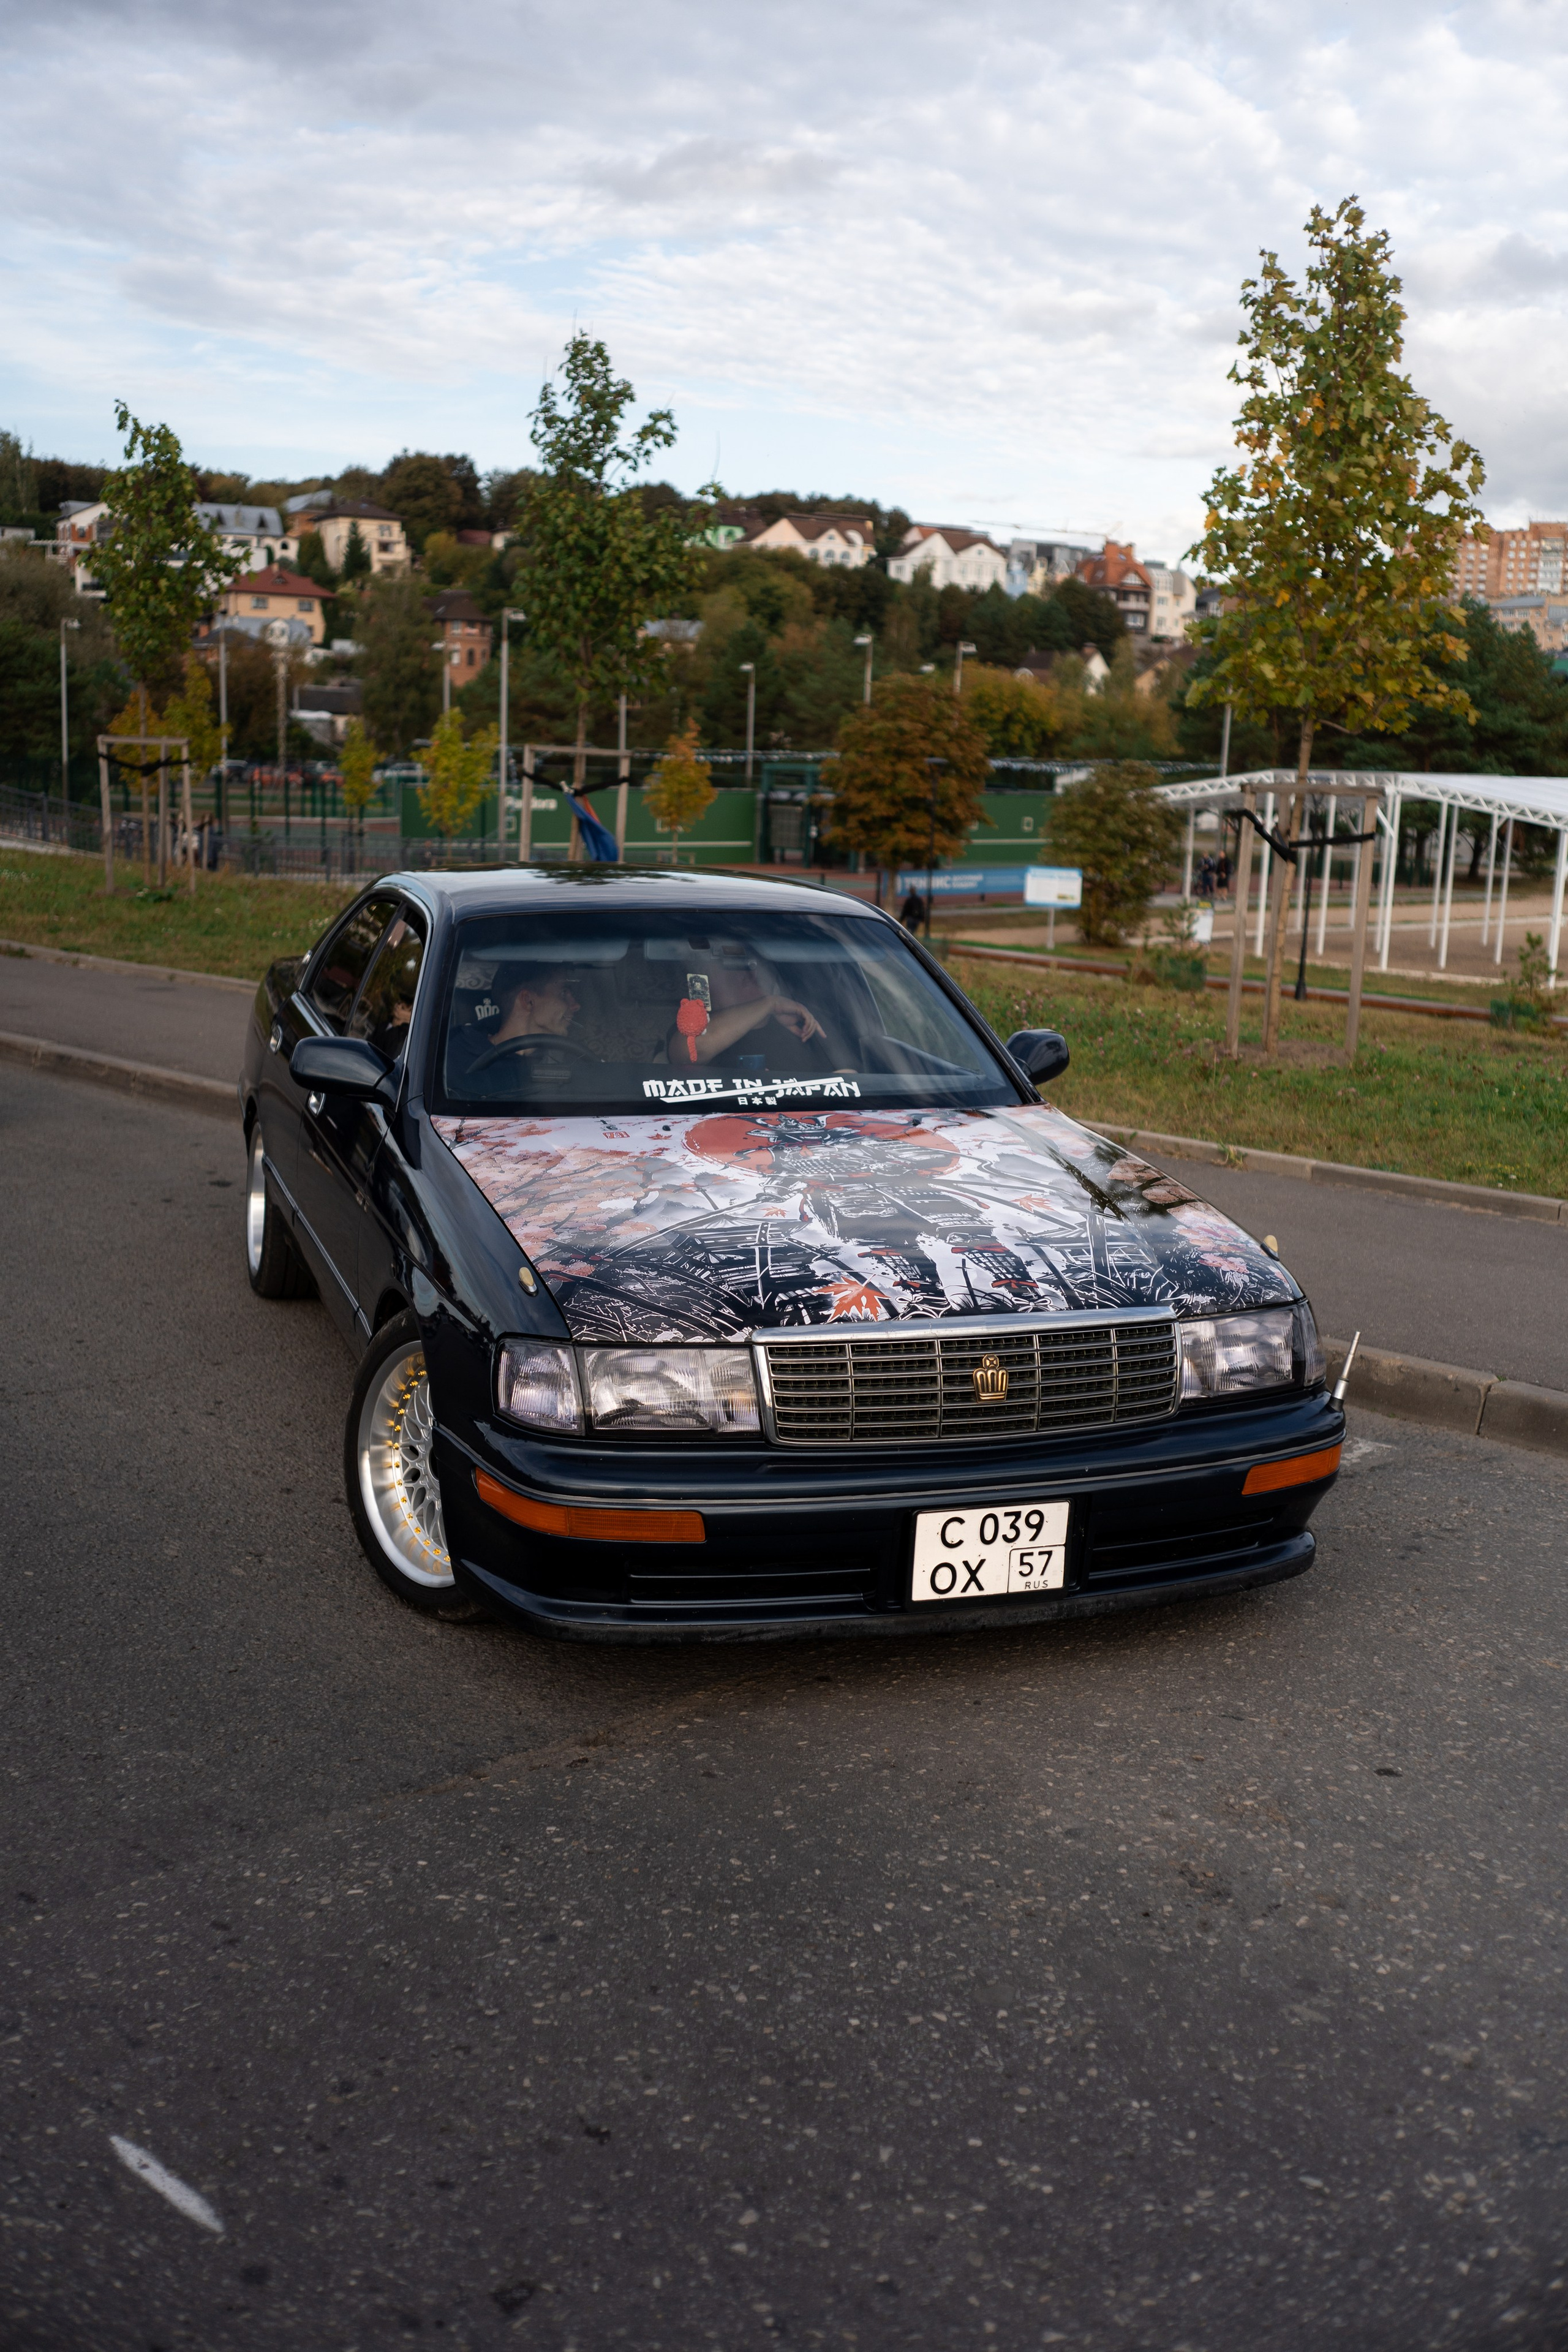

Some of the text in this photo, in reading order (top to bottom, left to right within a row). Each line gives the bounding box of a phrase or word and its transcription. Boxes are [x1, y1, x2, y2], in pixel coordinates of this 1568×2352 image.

[643, 1079, 723, 1097] MADE
[732, 1079, 765, 1095] IN
[737, 1096, 777, 1106] 日本製
[940, 1509, 1044, 1548] C 039
[1019, 1550, 1053, 1577] 57
[930, 1559, 986, 1594] OX
[1024, 1580, 1049, 1589] RUS
